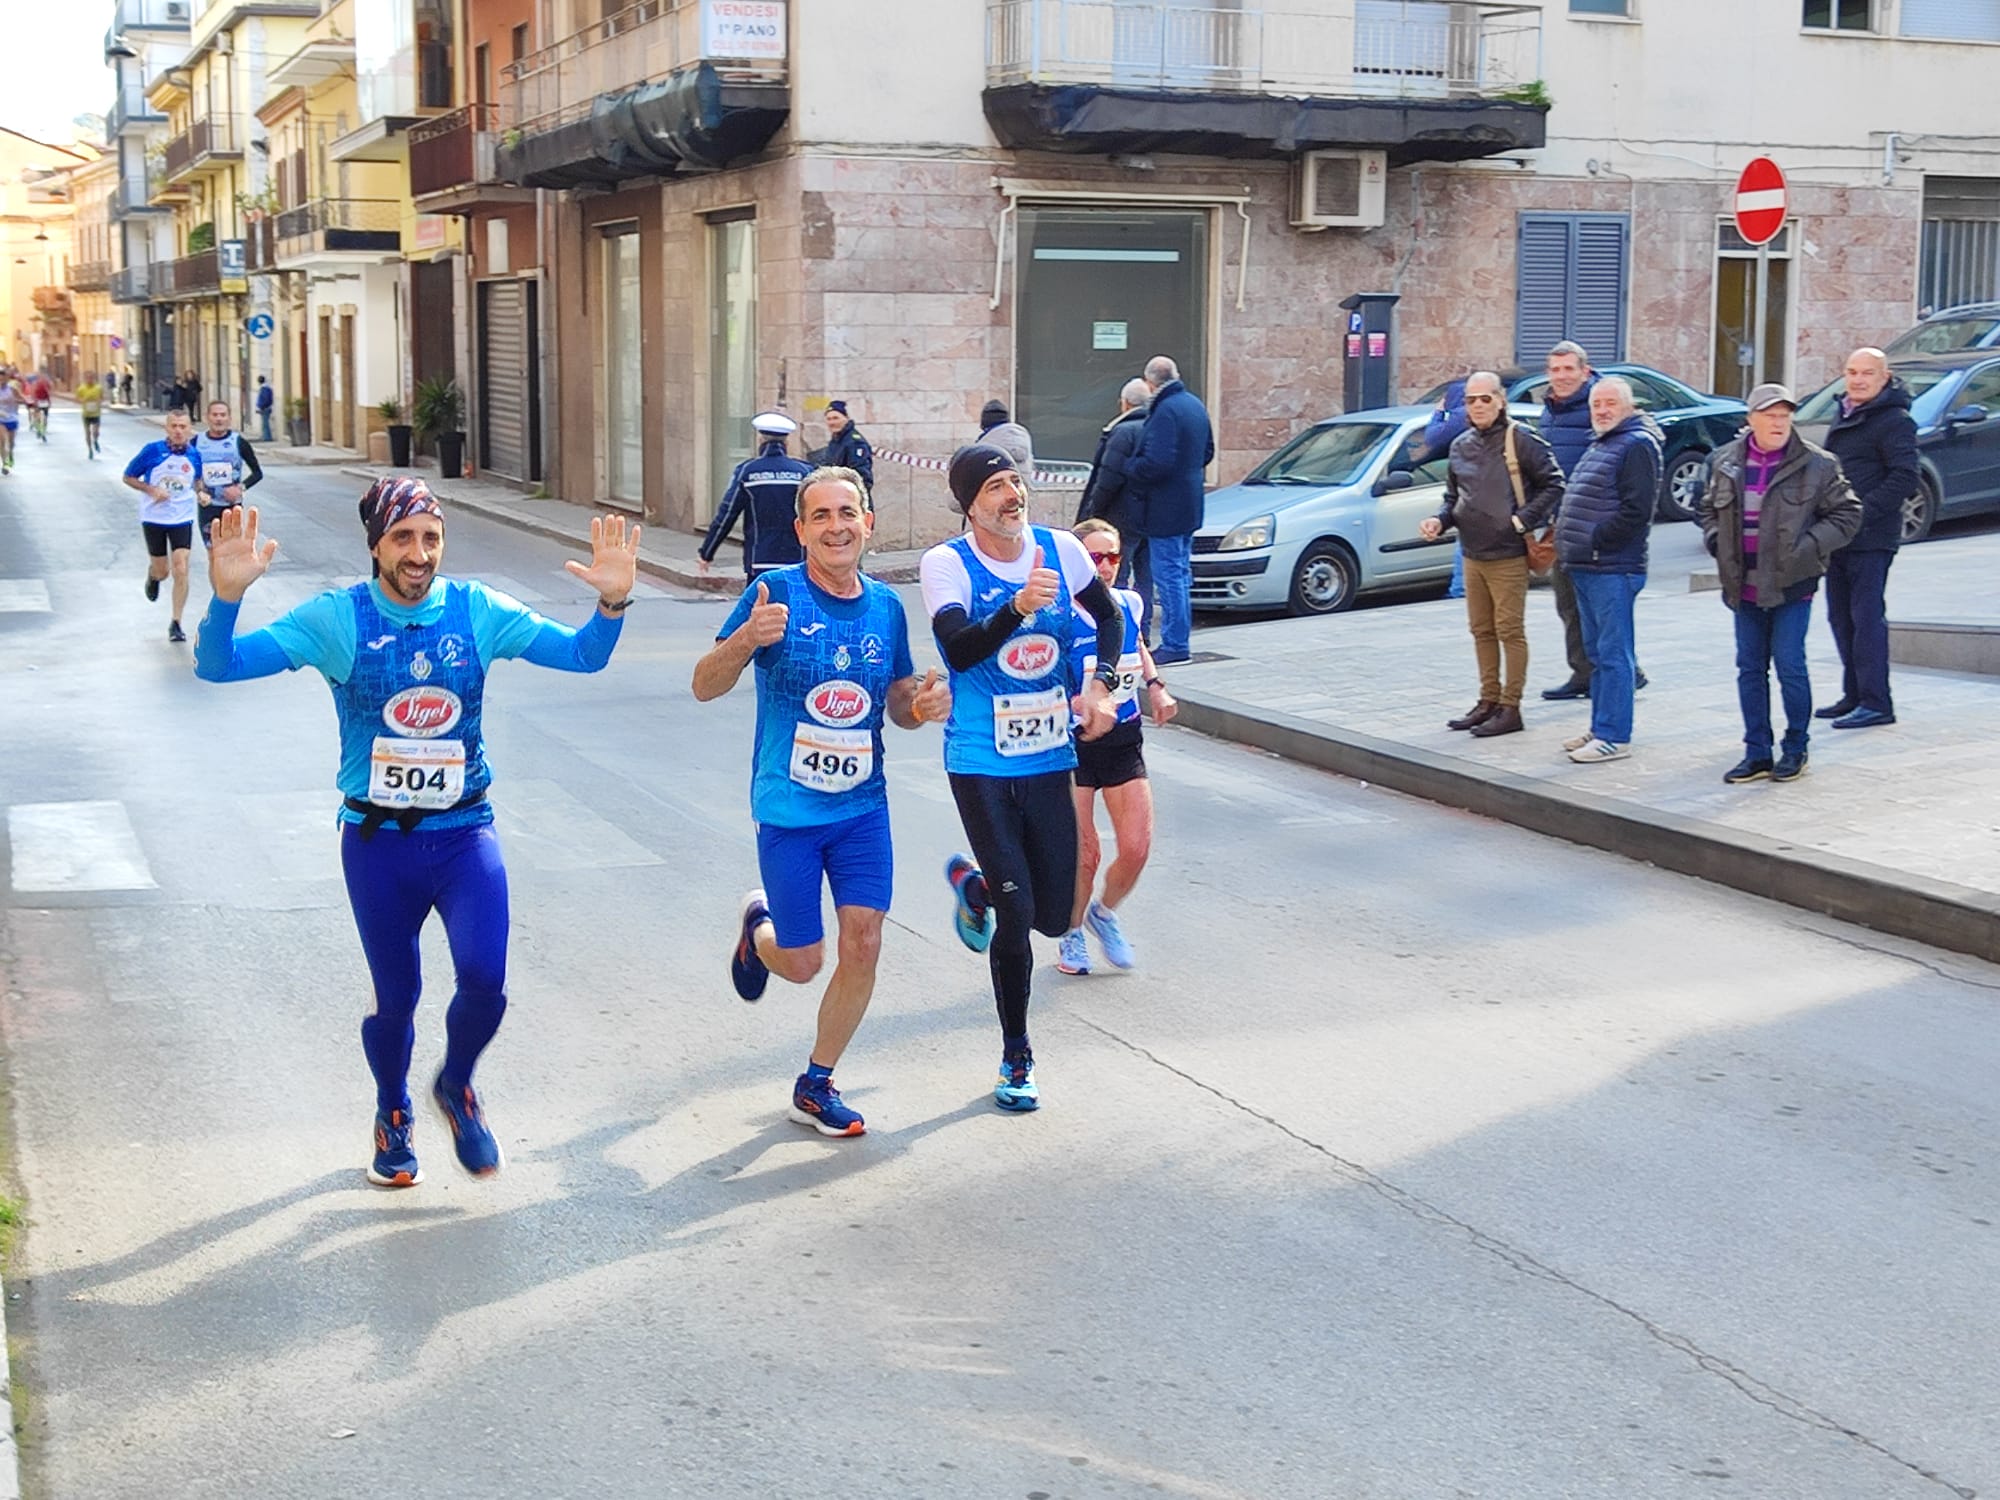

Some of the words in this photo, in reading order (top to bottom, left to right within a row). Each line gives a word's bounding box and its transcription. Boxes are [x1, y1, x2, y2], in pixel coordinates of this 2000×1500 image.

[712, 4, 778, 17] VENDESI
[733, 24, 777, 36] PANO
[1351, 313, 1361, 331] P
[402, 688, 448, 727] Sigel
[821, 686, 861, 717] Sigel
[1007, 715, 1054, 738] 521
[803, 751, 858, 777] 496
[384, 765, 446, 791] 504
